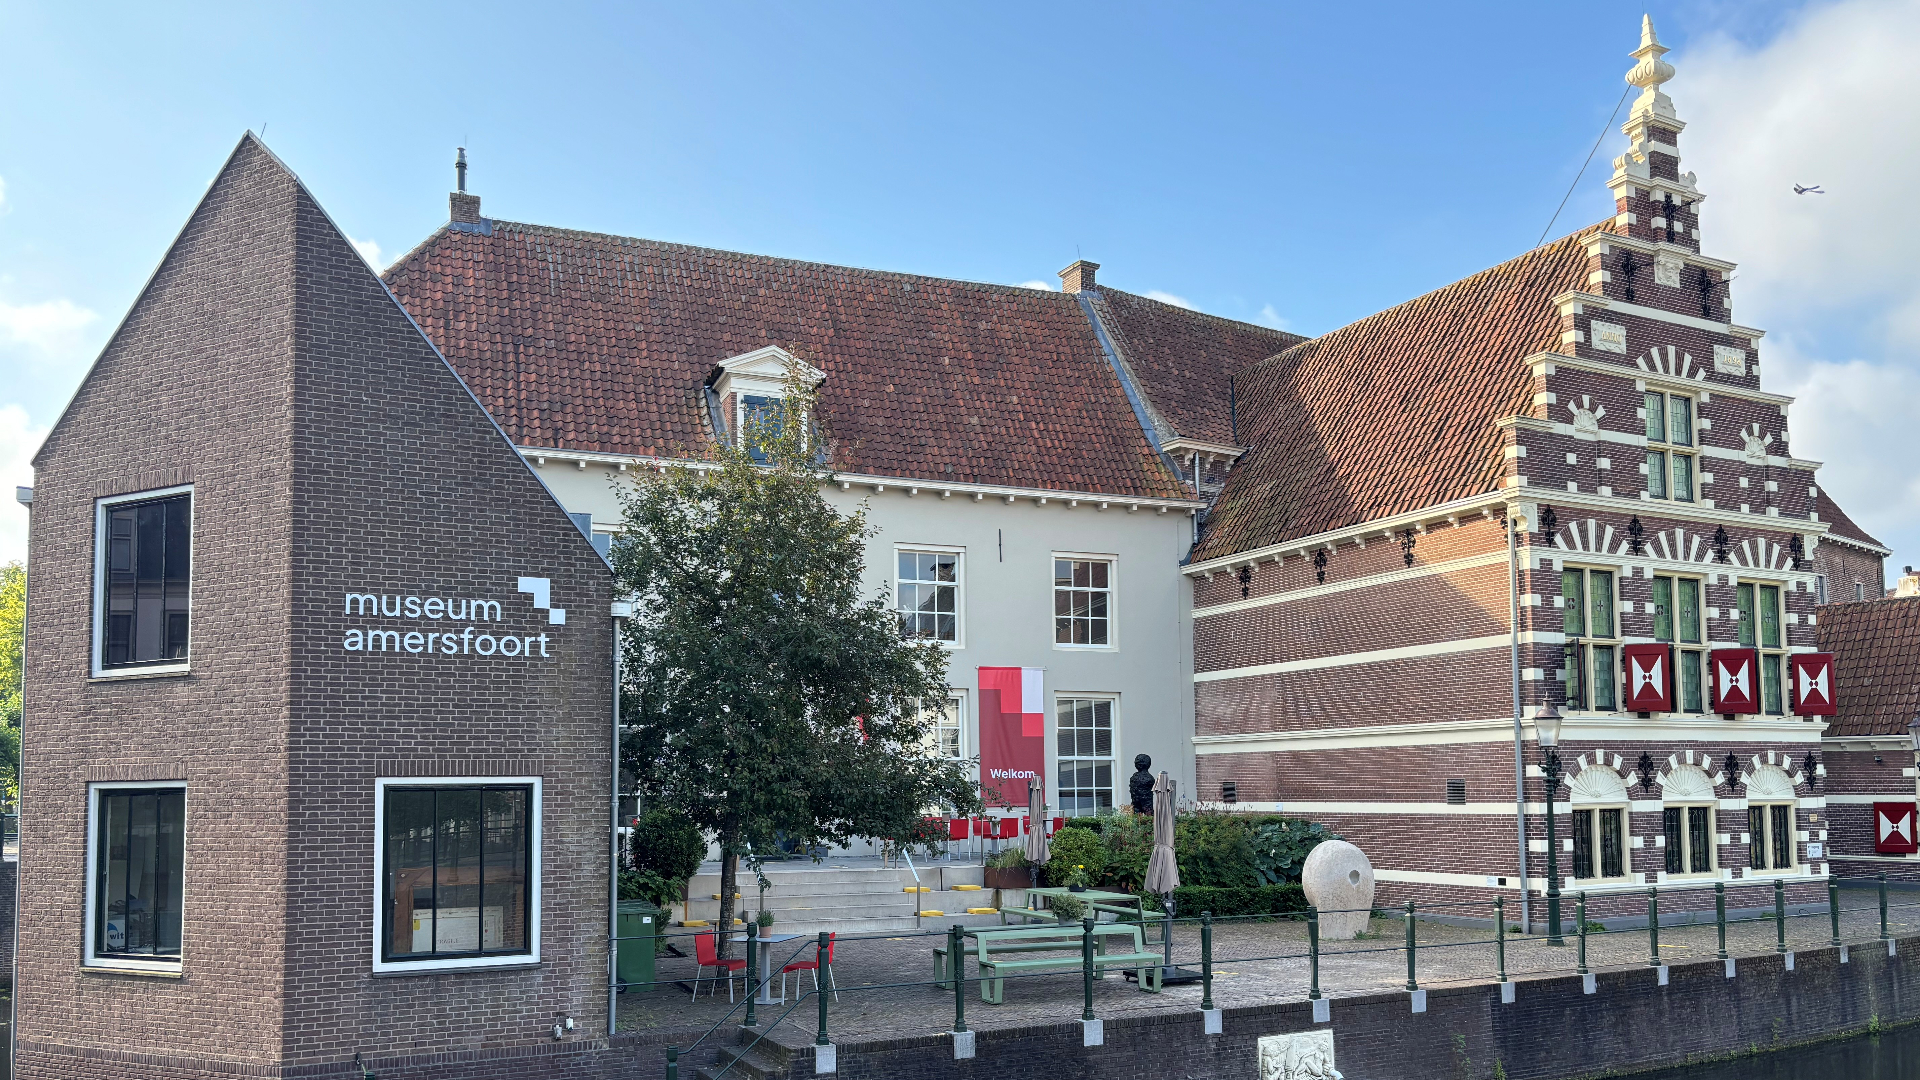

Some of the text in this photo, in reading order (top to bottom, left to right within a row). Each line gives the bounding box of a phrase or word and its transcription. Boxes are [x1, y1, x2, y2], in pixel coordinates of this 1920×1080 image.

[345, 593, 501, 622] museum
[343, 627, 550, 658] amersfoort
[990, 768, 1035, 779] Welkom
